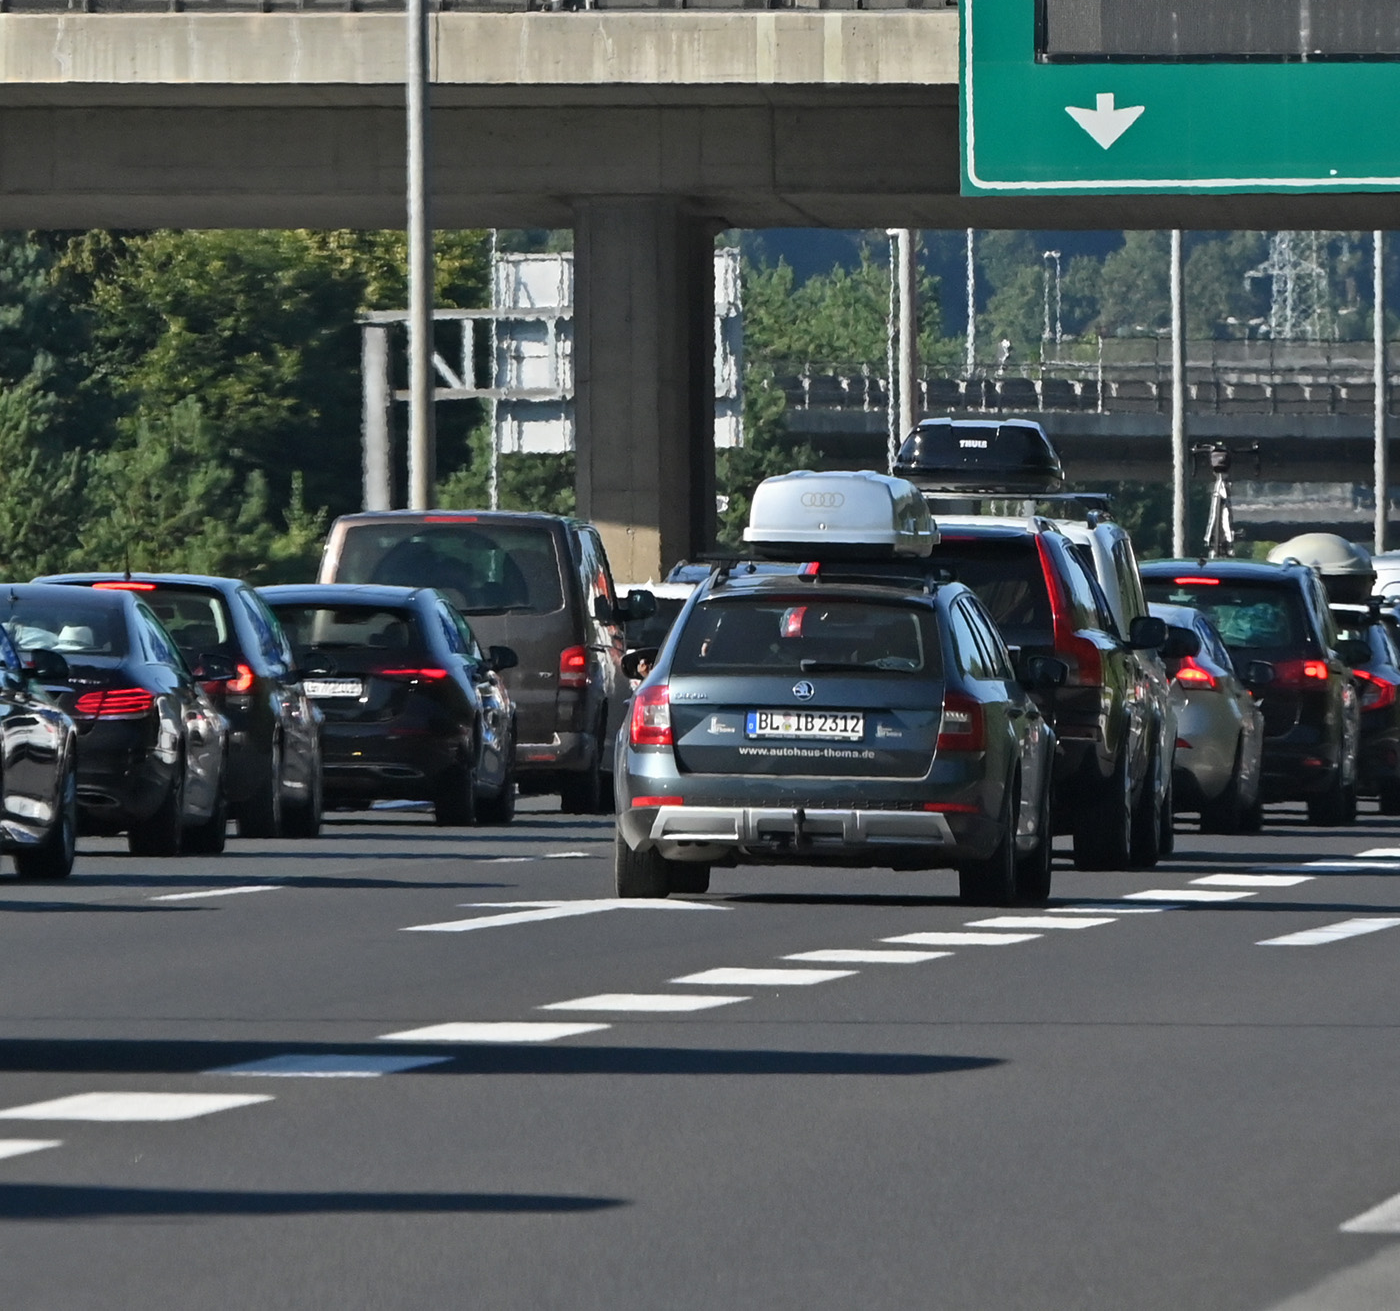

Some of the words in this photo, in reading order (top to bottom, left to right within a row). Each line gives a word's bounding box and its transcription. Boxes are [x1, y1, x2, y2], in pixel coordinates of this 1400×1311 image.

[959, 439, 988, 448] THULE
[758, 711, 780, 731] BL
[818, 714, 861, 734] 2312
[738, 747, 876, 760] www.autohaus-thoma.de
